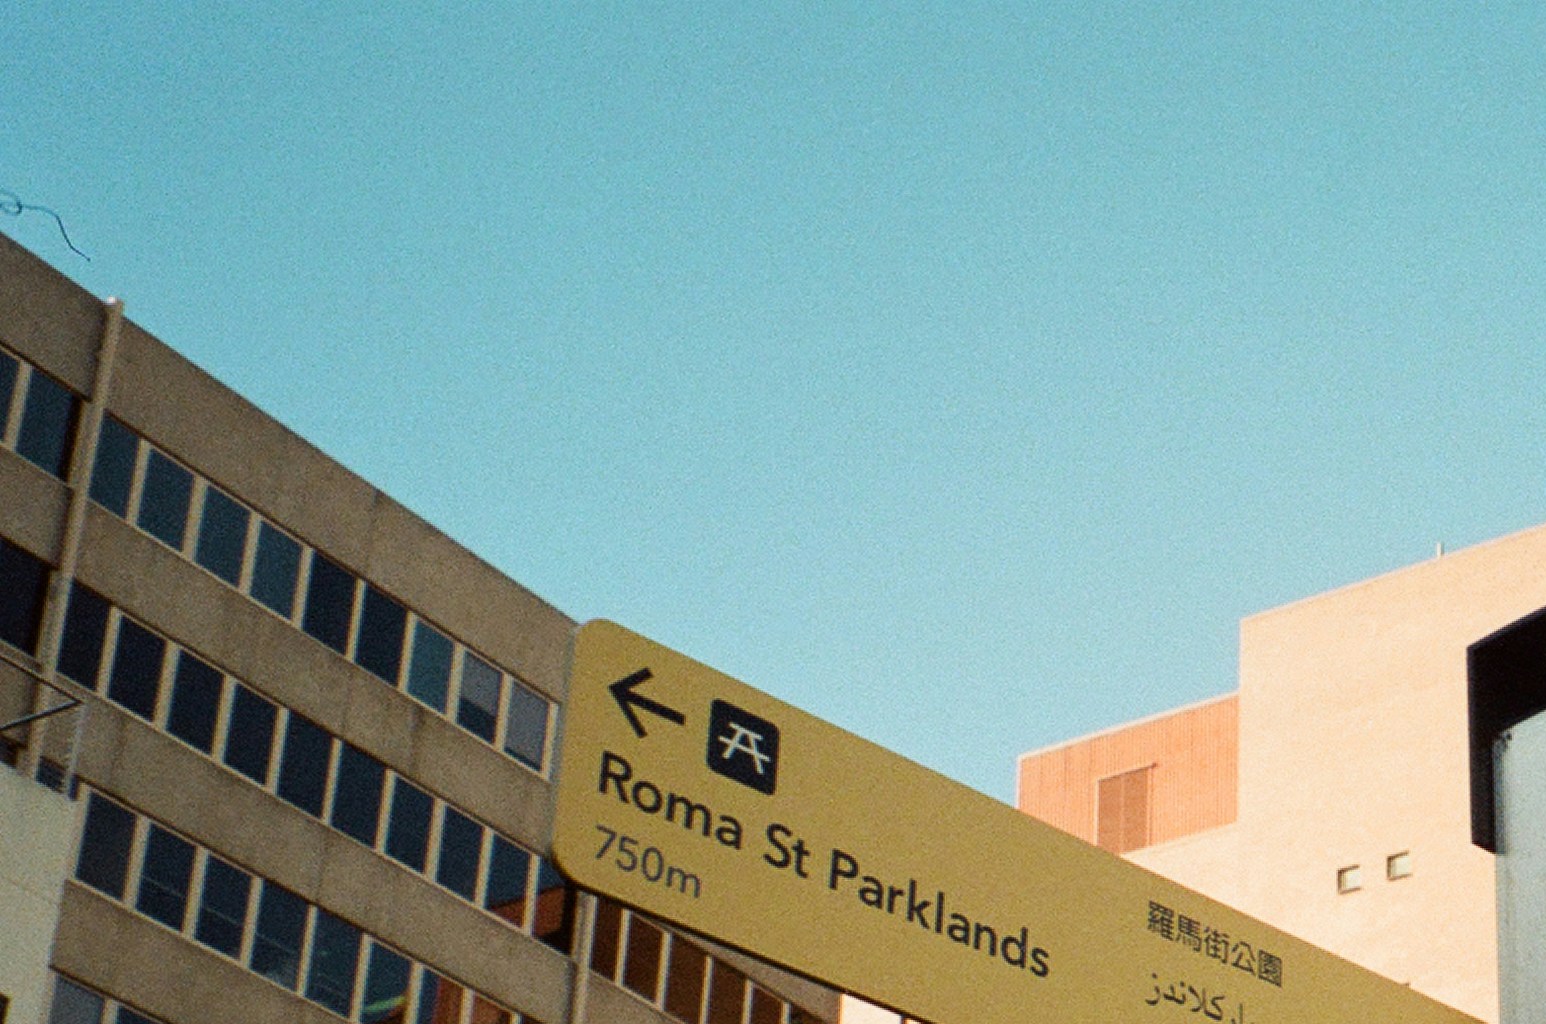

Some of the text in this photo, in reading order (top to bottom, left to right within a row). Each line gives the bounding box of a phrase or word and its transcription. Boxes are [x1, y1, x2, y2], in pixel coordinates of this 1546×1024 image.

[595, 826, 701, 898] 750m
[600, 751, 1049, 977] Roma St Parklands
[1148, 900, 1282, 987] 羅馬街公園
